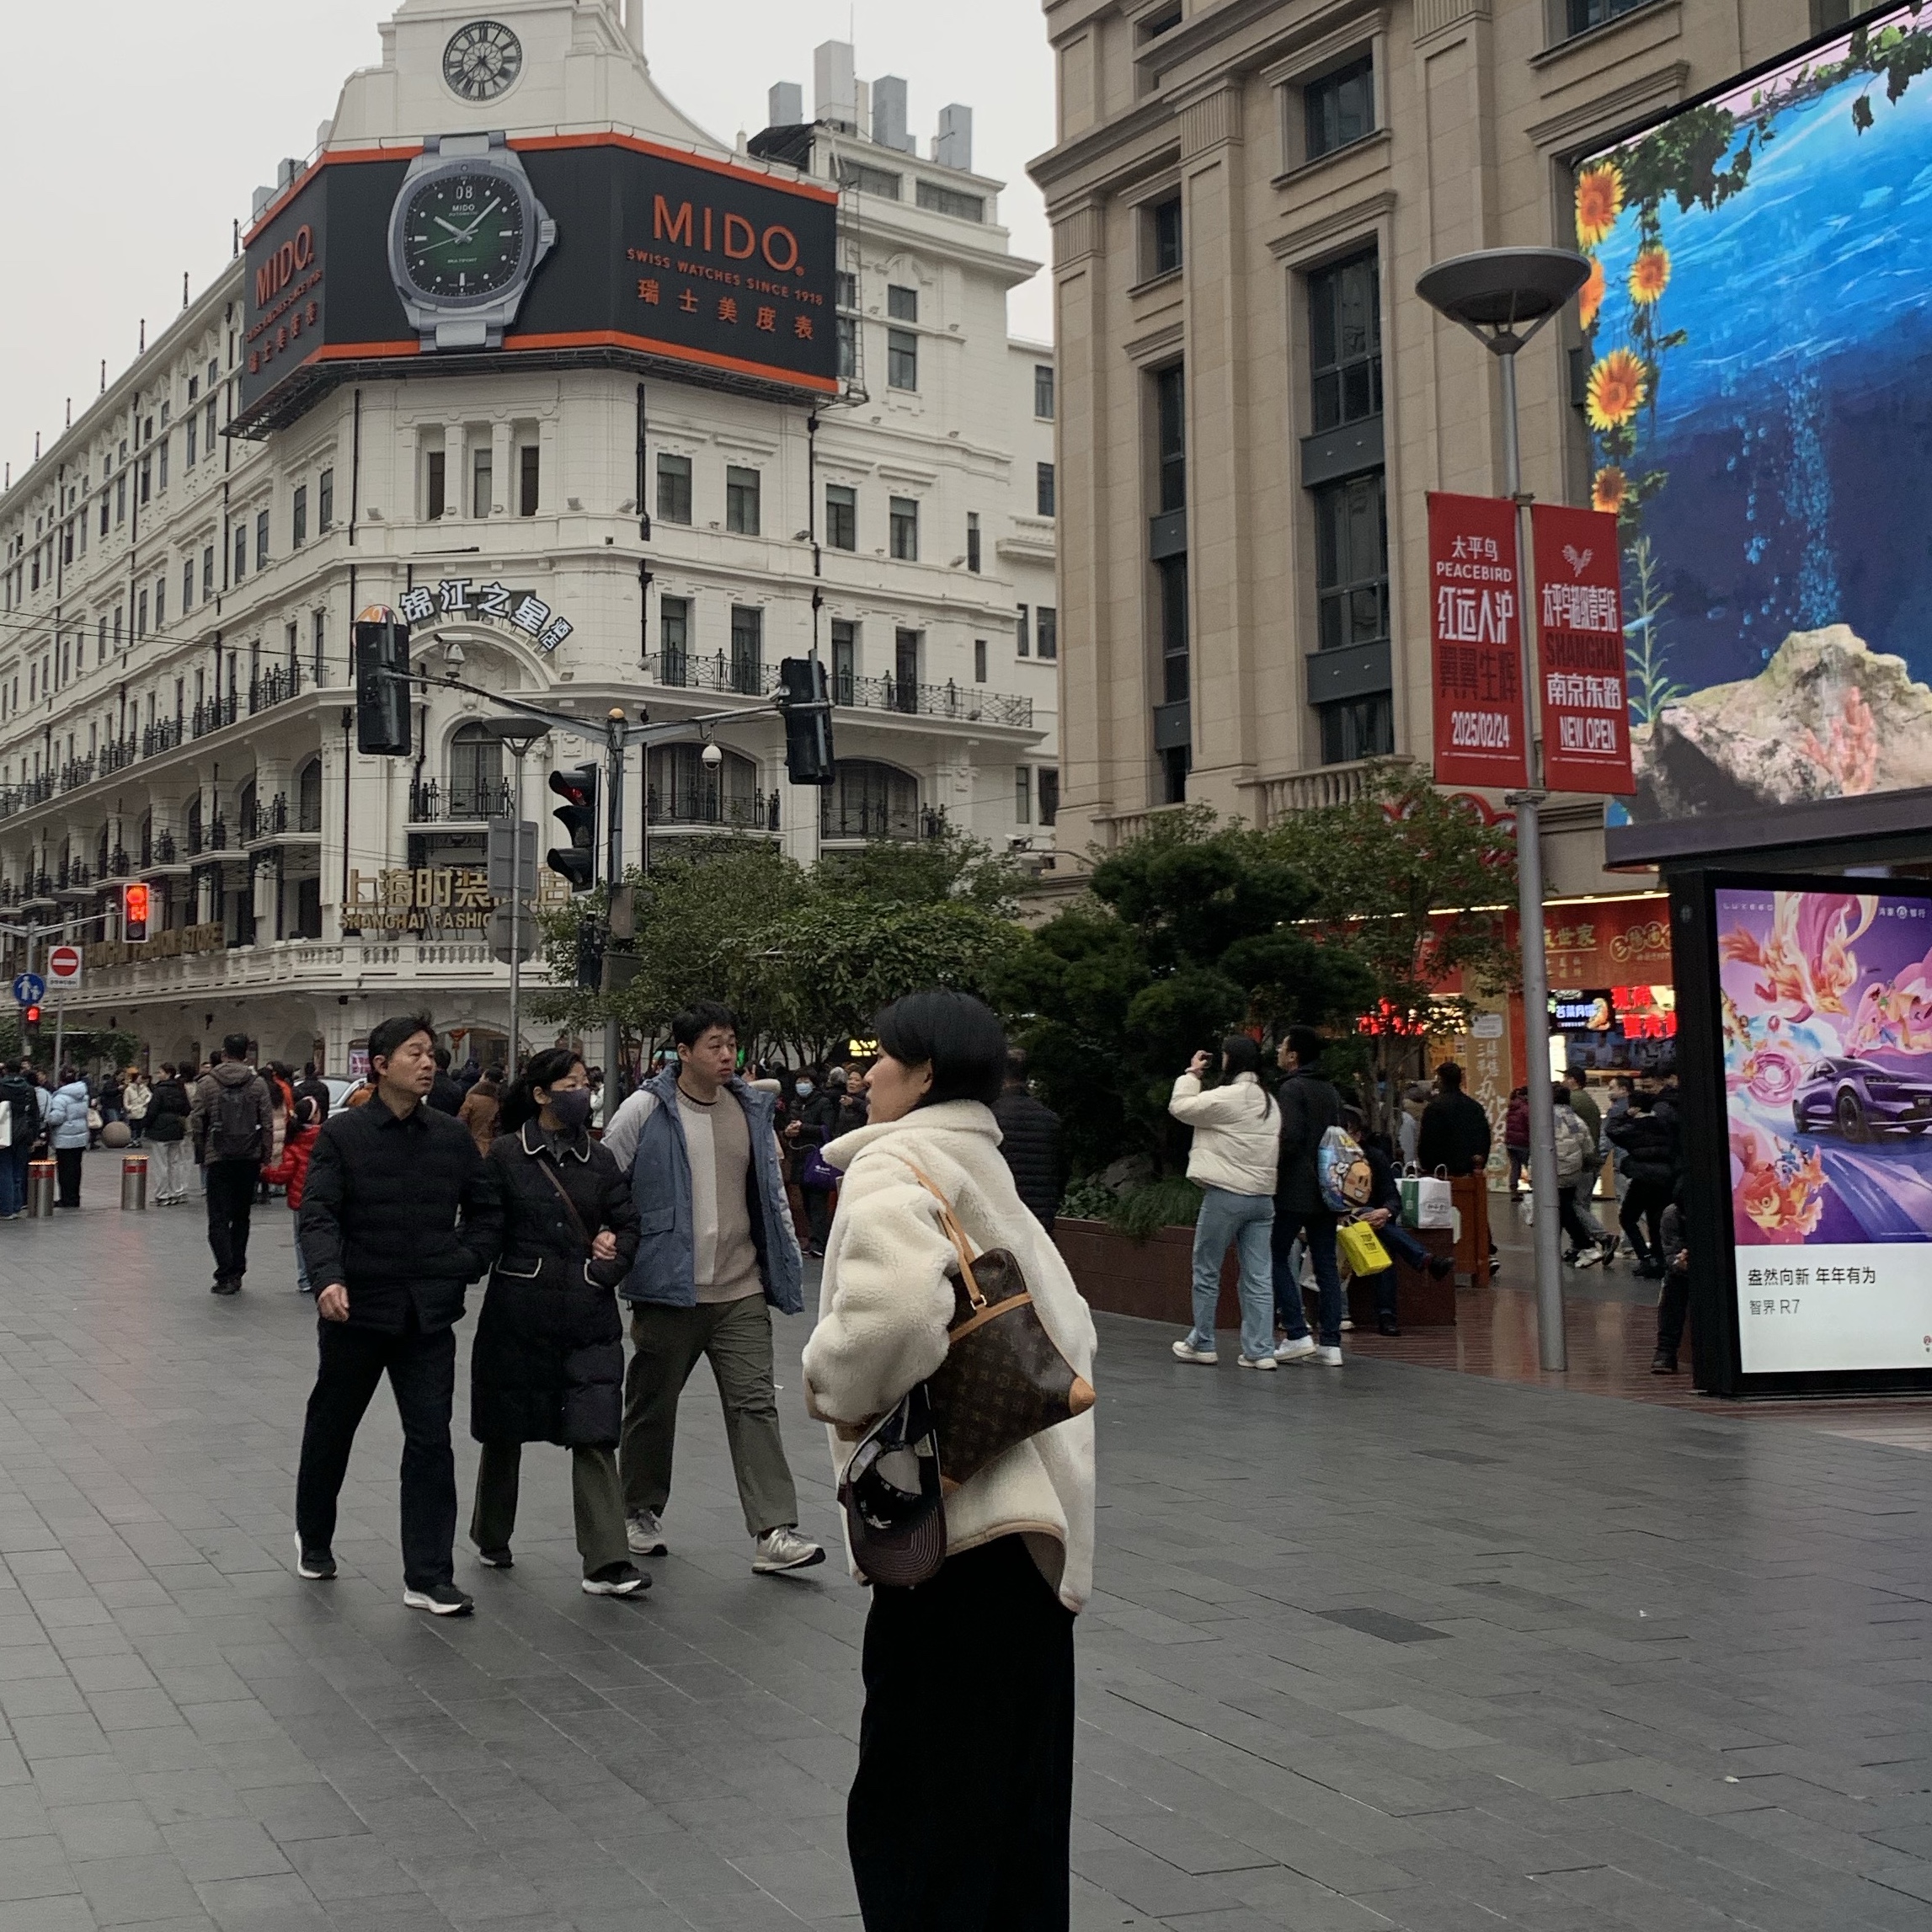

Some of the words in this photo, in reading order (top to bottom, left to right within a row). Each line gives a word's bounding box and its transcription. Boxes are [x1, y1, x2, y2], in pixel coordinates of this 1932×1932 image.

[653, 193, 798, 271] MIDO
[256, 224, 312, 310] MIDO
[627, 248, 670, 270] SWISS
[677, 260, 740, 286] WATCHES
[746, 277, 789, 298] SINCE
[794, 290, 824, 306] 1918
[638, 279, 814, 340] 瑞士美度表
[1451, 536, 1498, 563] 太平鸟
[1436, 561, 1513, 583] PEACEBIRD
[1546, 672, 1622, 710] 南京东路
[1451, 711, 1511, 748] 2025/02/24
[1559, 716, 1583, 748] NEW
[1587, 718, 1617, 750] OPEN
[340, 868, 571, 907] 上海时装店
[340, 912, 424, 930] SHANGHAI
[1748, 1268, 1810, 1286] 盎然向新
[1816, 1267, 1876, 1285] 年年有为
[1749, 1300, 1775, 1315] 智界
[1780, 1300, 1801, 1314] R7
